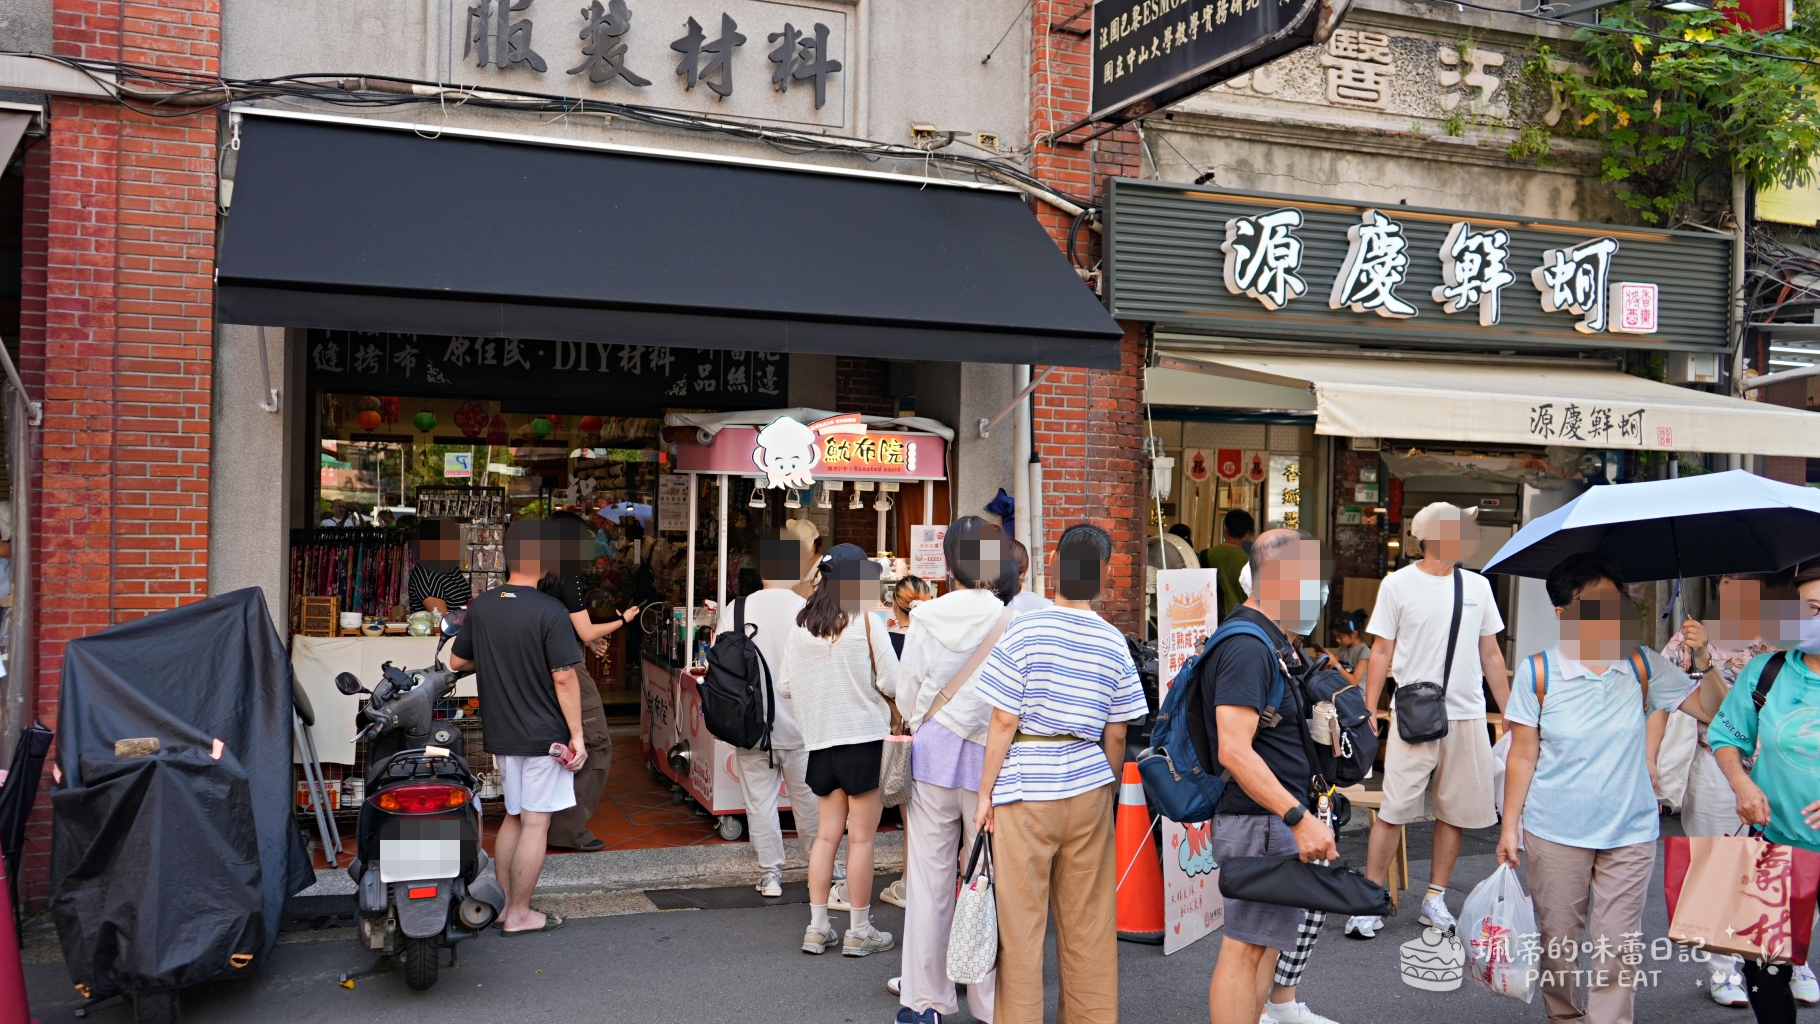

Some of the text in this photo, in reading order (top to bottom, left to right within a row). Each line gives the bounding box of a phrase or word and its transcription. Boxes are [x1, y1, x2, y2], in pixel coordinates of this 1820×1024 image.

[464, 0, 842, 110] 服裝材料
[1226, 207, 1619, 333] 源慶鮮蚵
[312, 331, 345, 373] 縫
[393, 334, 419, 378] 布
[1530, 403, 1646, 446] 源慶鮮蚵
